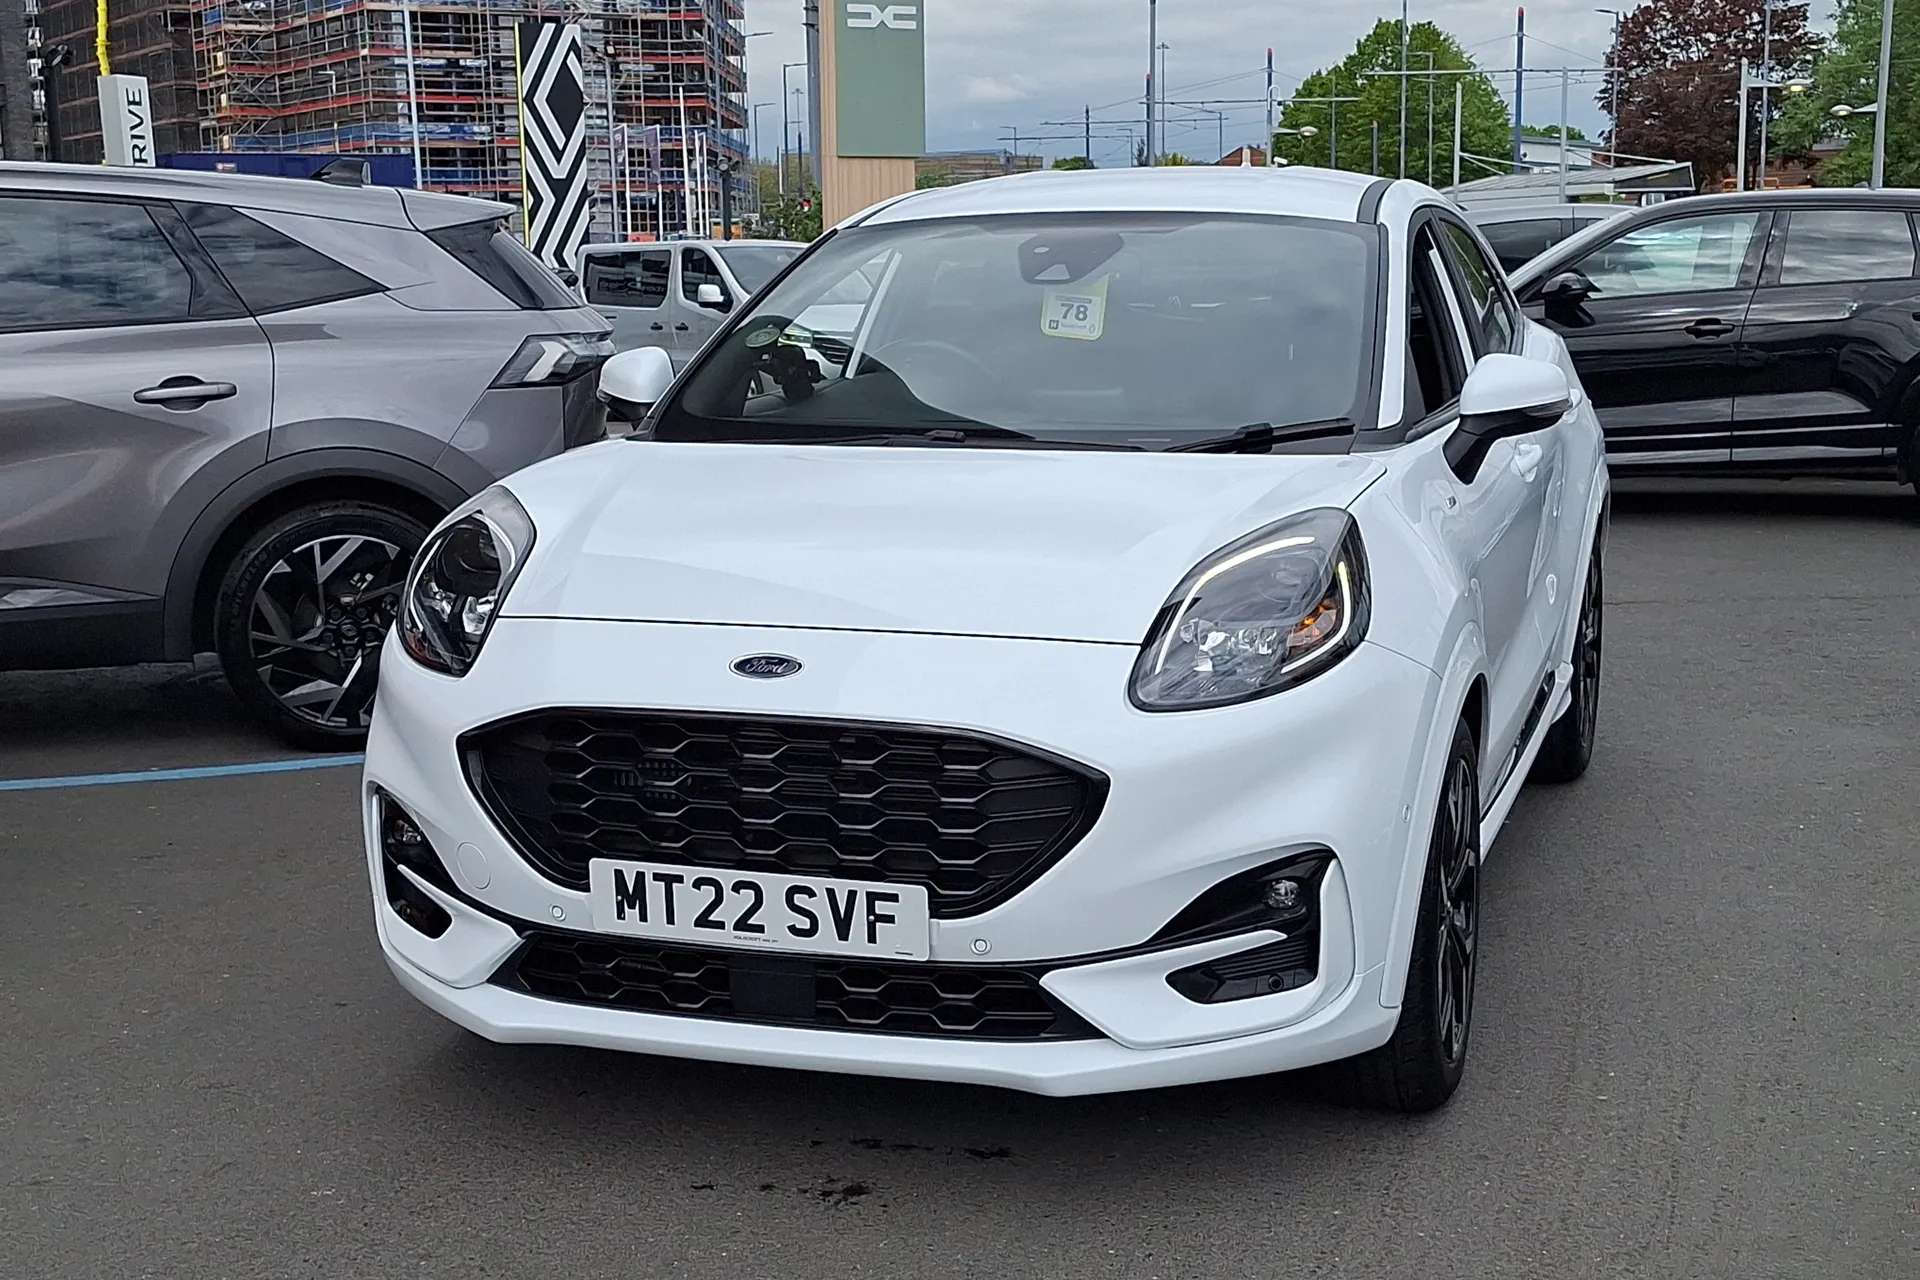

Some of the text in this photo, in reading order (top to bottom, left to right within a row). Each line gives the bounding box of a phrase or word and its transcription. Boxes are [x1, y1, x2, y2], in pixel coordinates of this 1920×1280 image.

[1060, 303, 1089, 322] 78
[745, 657, 788, 673] Ford
[613, 868, 900, 945] MT22 SVF
